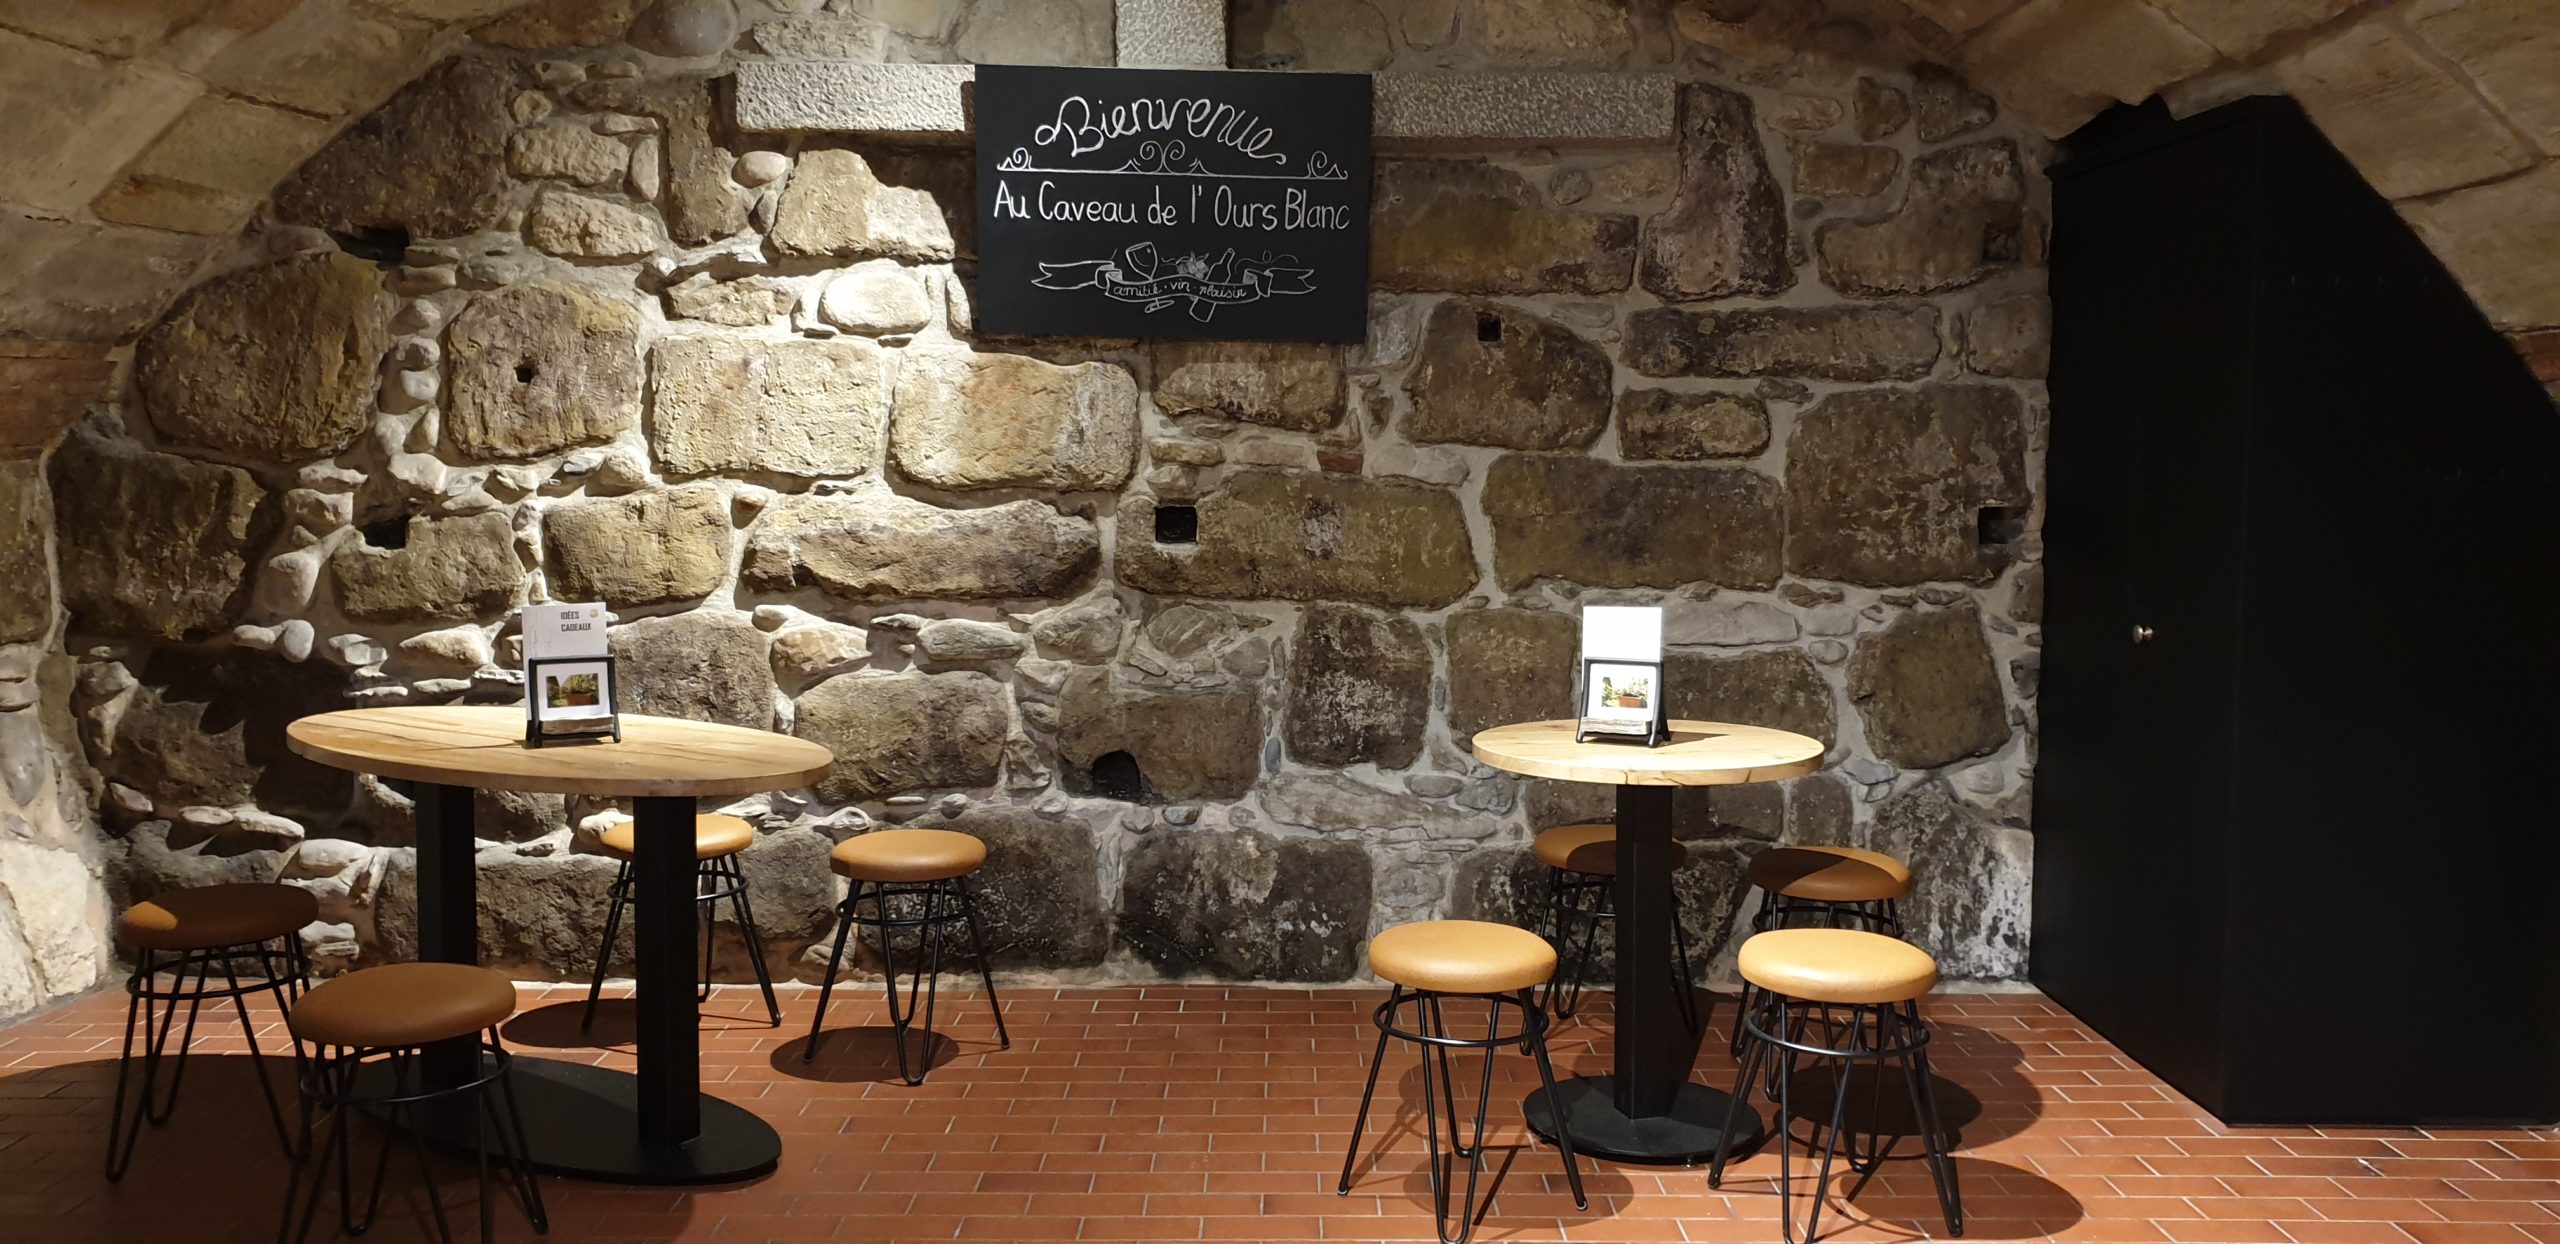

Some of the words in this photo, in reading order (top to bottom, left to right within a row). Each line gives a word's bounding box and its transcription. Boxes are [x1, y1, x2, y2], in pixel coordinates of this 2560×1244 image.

[1034, 96, 1287, 165] Bienvenue
[993, 179, 1031, 220] Au
[1038, 180, 1139, 224] Caveau
[1147, 184, 1178, 226] de
[1284, 187, 1350, 231] Blanc
[1169, 278, 1191, 292] vin
[560, 610, 580, 620] IDÉES
[561, 622, 592, 632] CADEAUX
